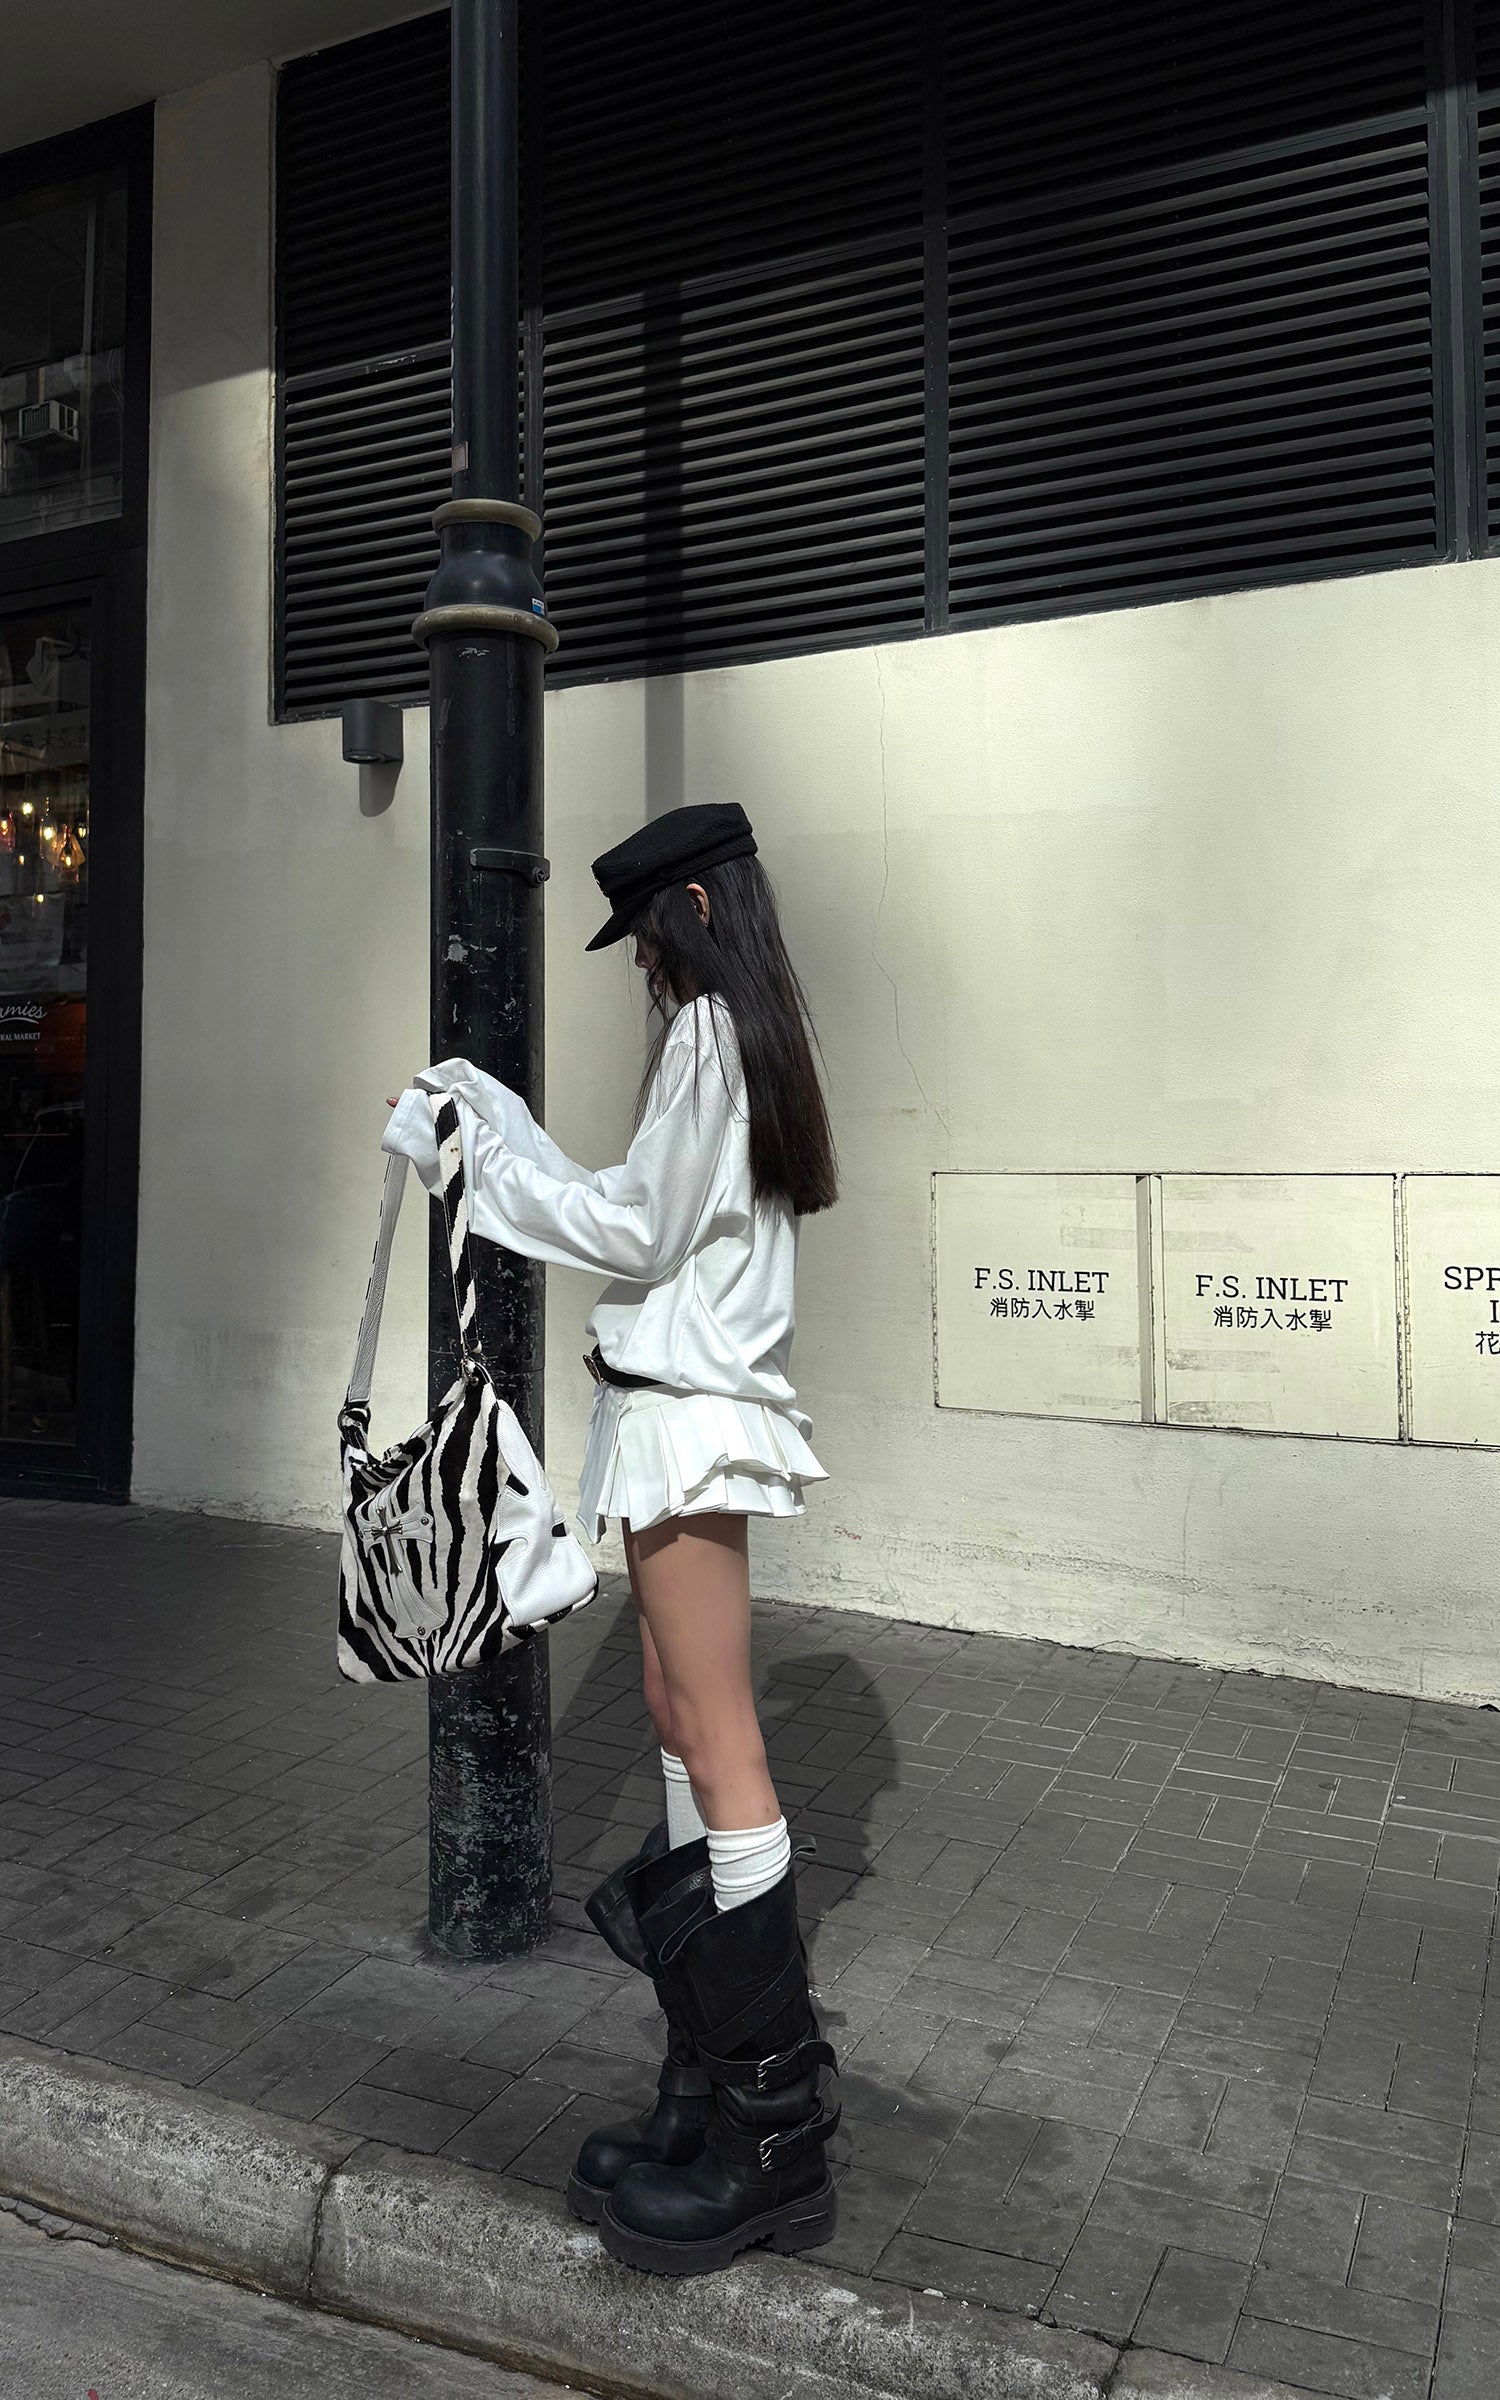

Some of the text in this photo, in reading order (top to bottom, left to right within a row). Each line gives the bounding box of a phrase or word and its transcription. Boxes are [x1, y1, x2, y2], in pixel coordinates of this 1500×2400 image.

[14, 1031, 41, 1041] MARKET
[974, 1267, 1110, 1294] F.S. INLET
[1195, 1274, 1349, 1303] F.S. INLET
[989, 1296, 1096, 1322] 消防入水掣
[1213, 1305, 1333, 1332] 消防入水掣
